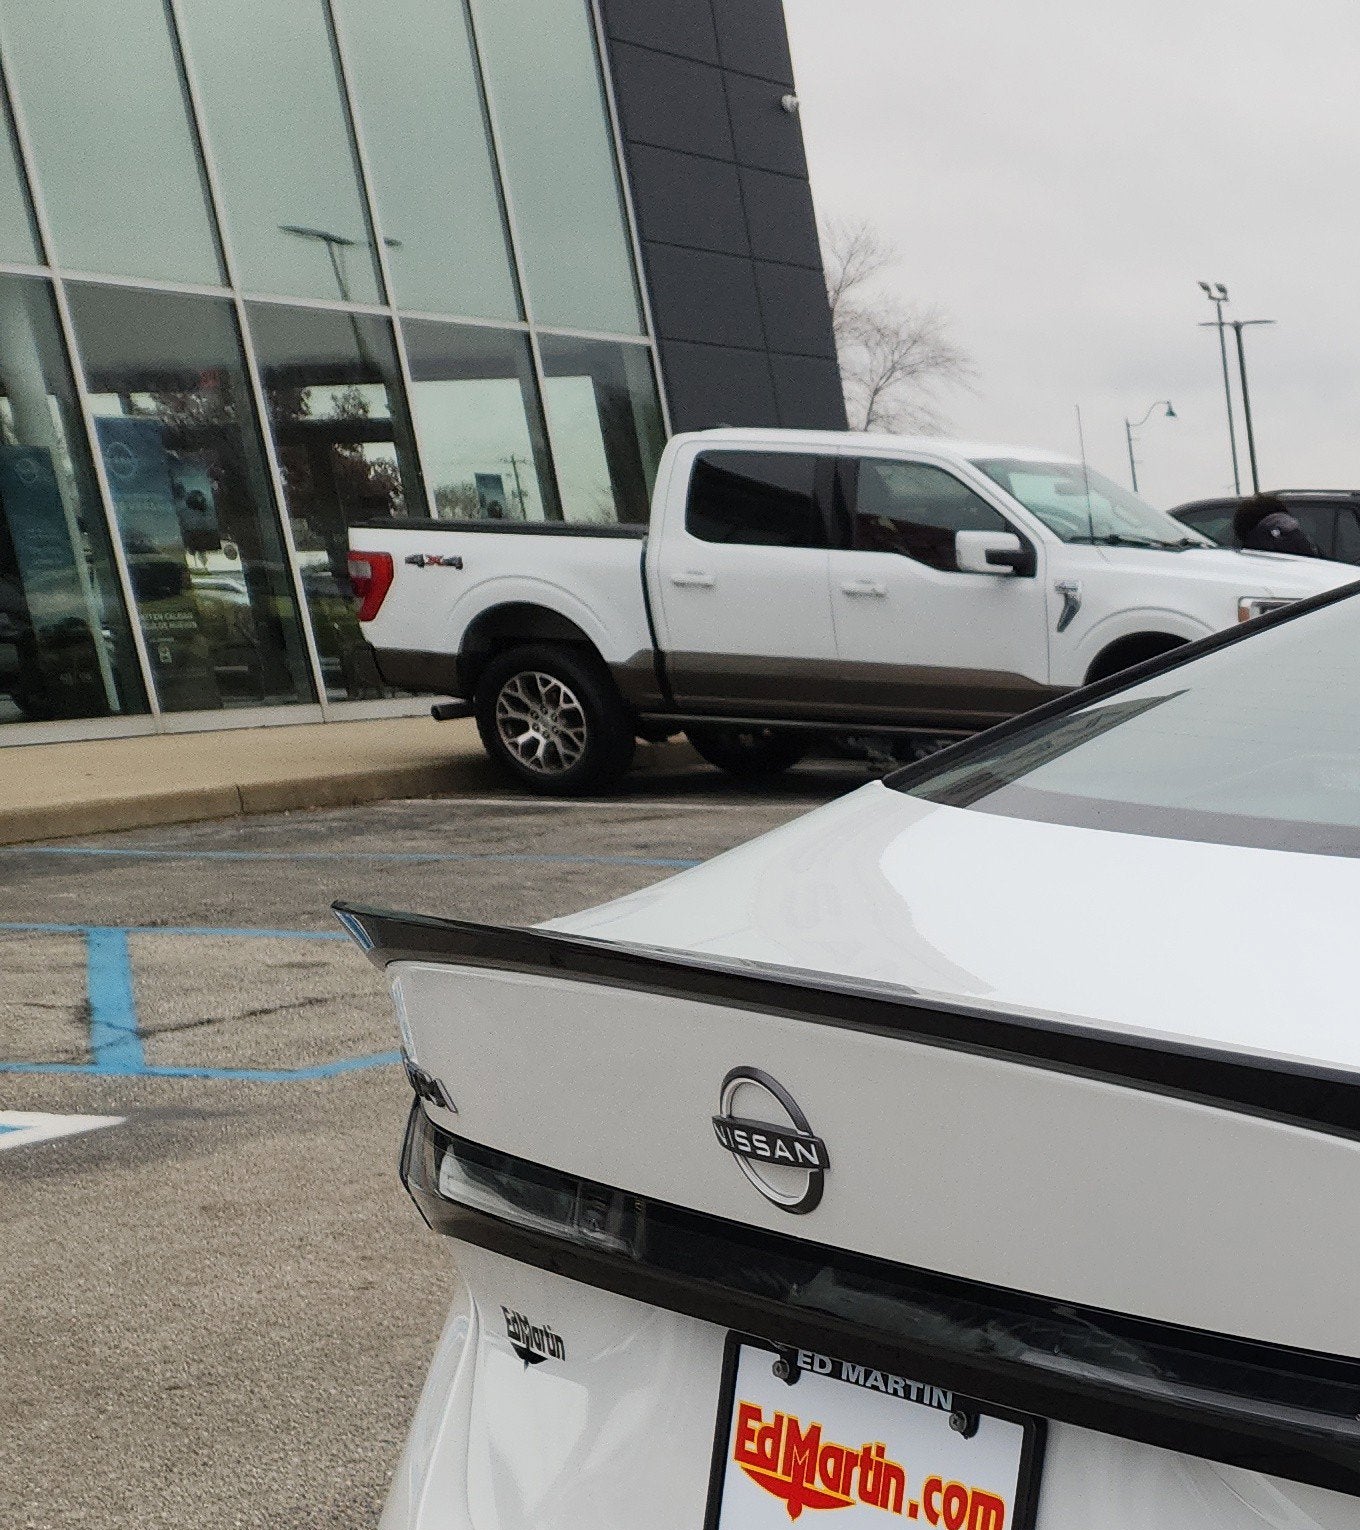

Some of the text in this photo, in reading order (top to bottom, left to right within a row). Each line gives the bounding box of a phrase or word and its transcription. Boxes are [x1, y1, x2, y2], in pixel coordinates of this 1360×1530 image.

[712, 1121, 821, 1166] NISSAN
[797, 1351, 954, 1411] ED MARTIN
